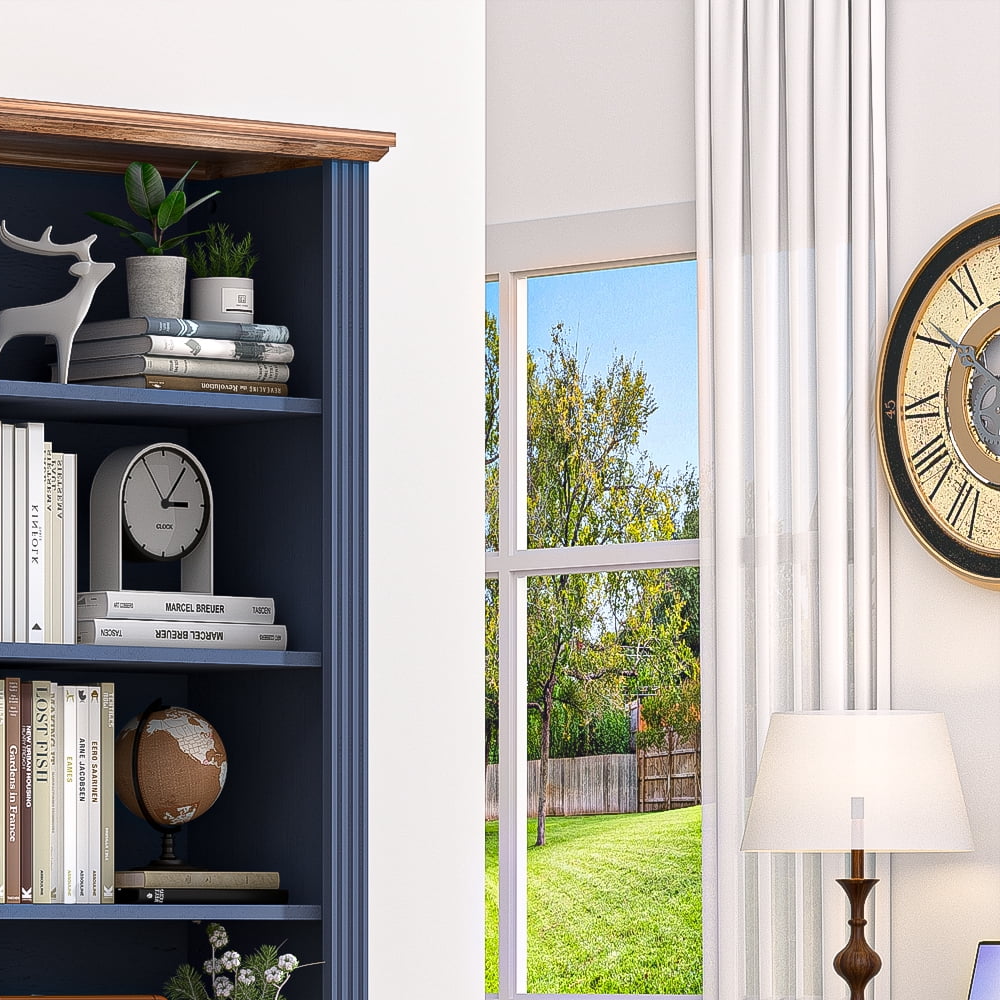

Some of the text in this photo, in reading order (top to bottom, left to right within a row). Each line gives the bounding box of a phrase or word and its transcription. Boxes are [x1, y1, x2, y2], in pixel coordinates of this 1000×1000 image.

[201, 382, 238, 392] Revolution
[884, 399, 896, 420] 45
[165, 602, 225, 614] MARCEL BREUER
[155, 629, 224, 641] MARCEL BREUER
[36, 687, 48, 783] LOST FISH
[9, 744, 18, 842] Gardens in France
